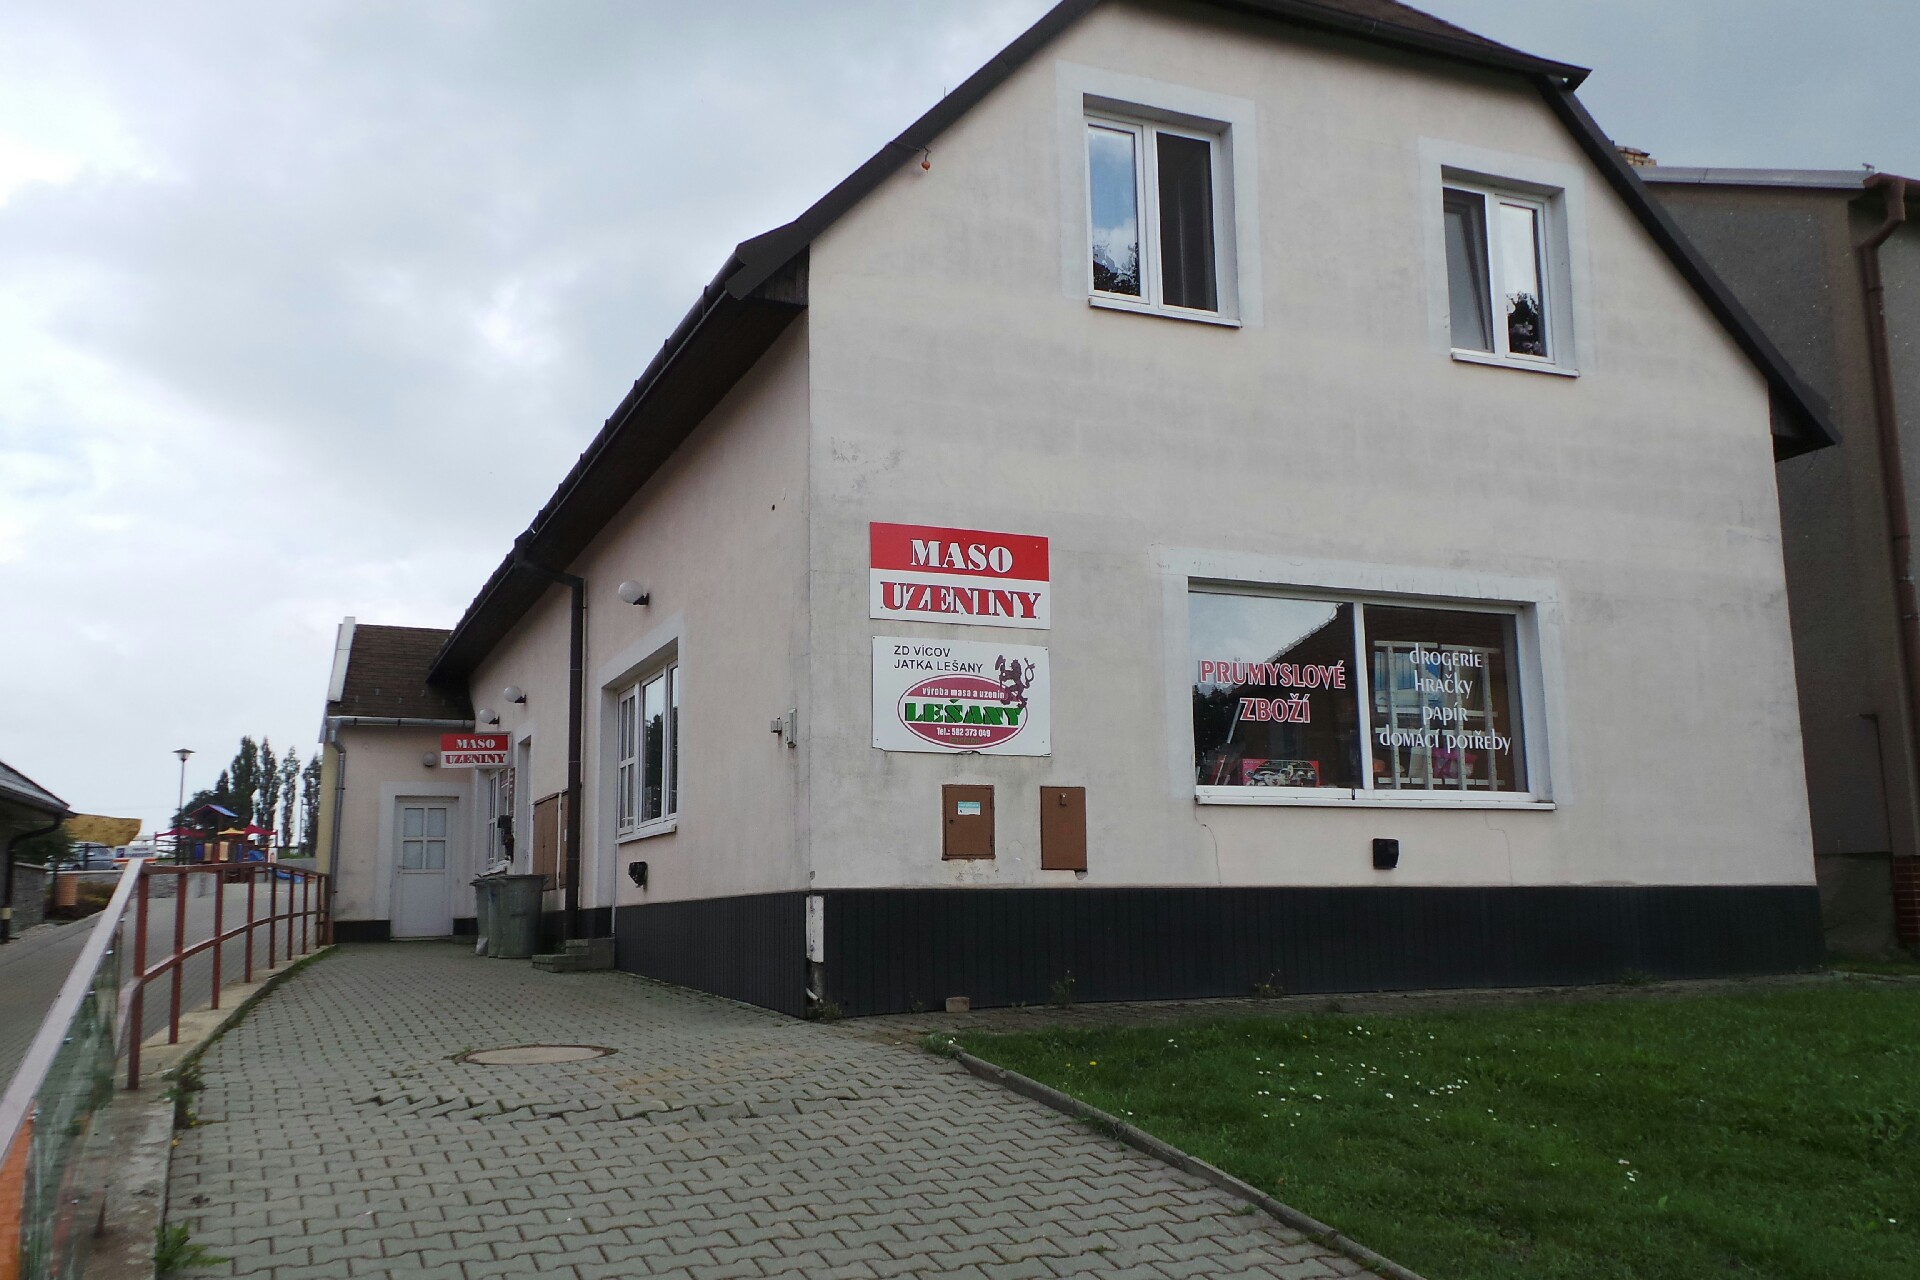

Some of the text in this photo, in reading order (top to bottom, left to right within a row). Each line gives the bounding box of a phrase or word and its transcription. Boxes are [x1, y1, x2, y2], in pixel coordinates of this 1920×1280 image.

[910, 539, 1013, 573] MASO
[880, 581, 1041, 619] UZENINY
[894, 644, 951, 657] ZD VÍCOV
[894, 659, 984, 673] JATKA LEŠANY
[922, 686, 949, 696] výroba
[904, 698, 1024, 726] LEŠANY
[1240, 692, 1311, 723] ZBOŽÍ
[965, 728, 978, 737] 373
[978, 729, 991, 738] 049
[456, 739, 496, 749] MASO
[445, 753, 506, 764] UZENINY
